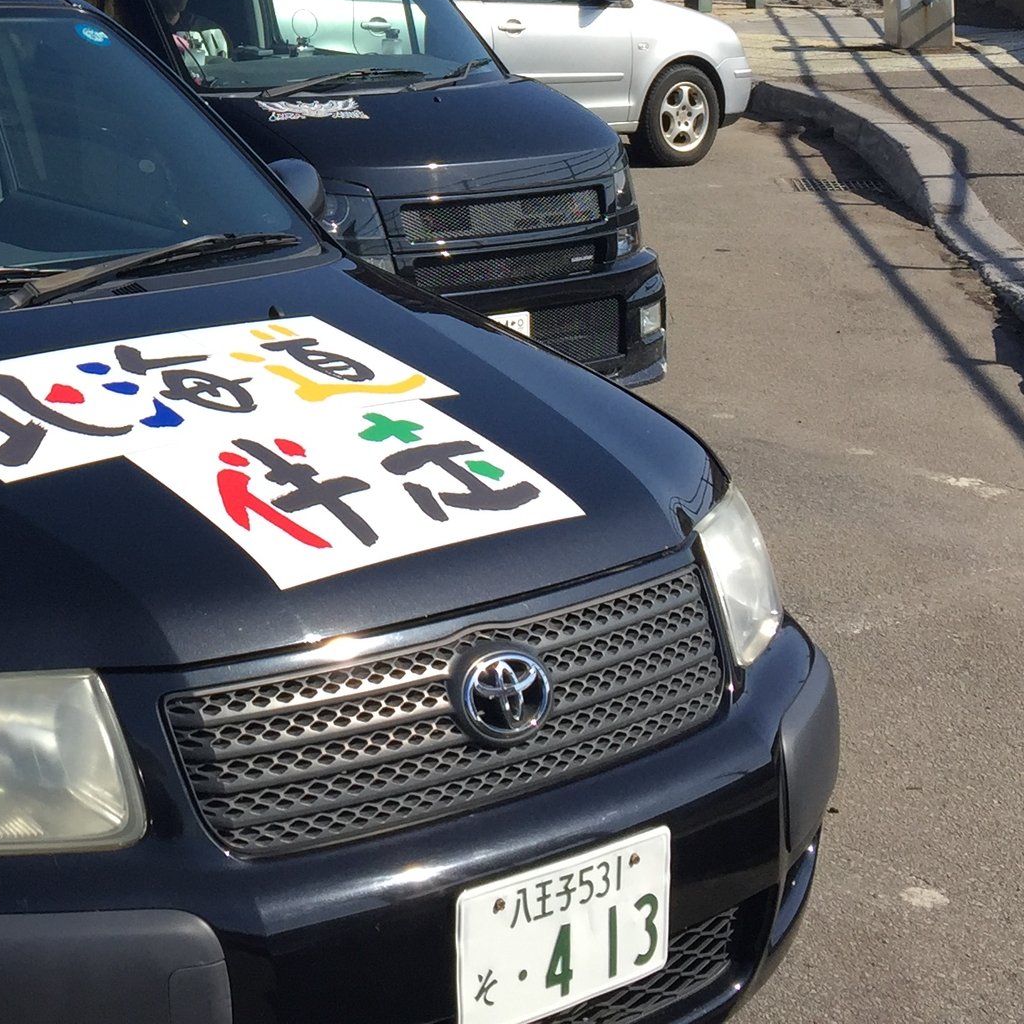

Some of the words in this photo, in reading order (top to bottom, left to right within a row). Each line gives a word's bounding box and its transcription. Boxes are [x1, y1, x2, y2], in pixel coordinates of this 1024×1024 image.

[510, 855, 622, 929] 八王子531
[474, 969, 498, 1006] そ
